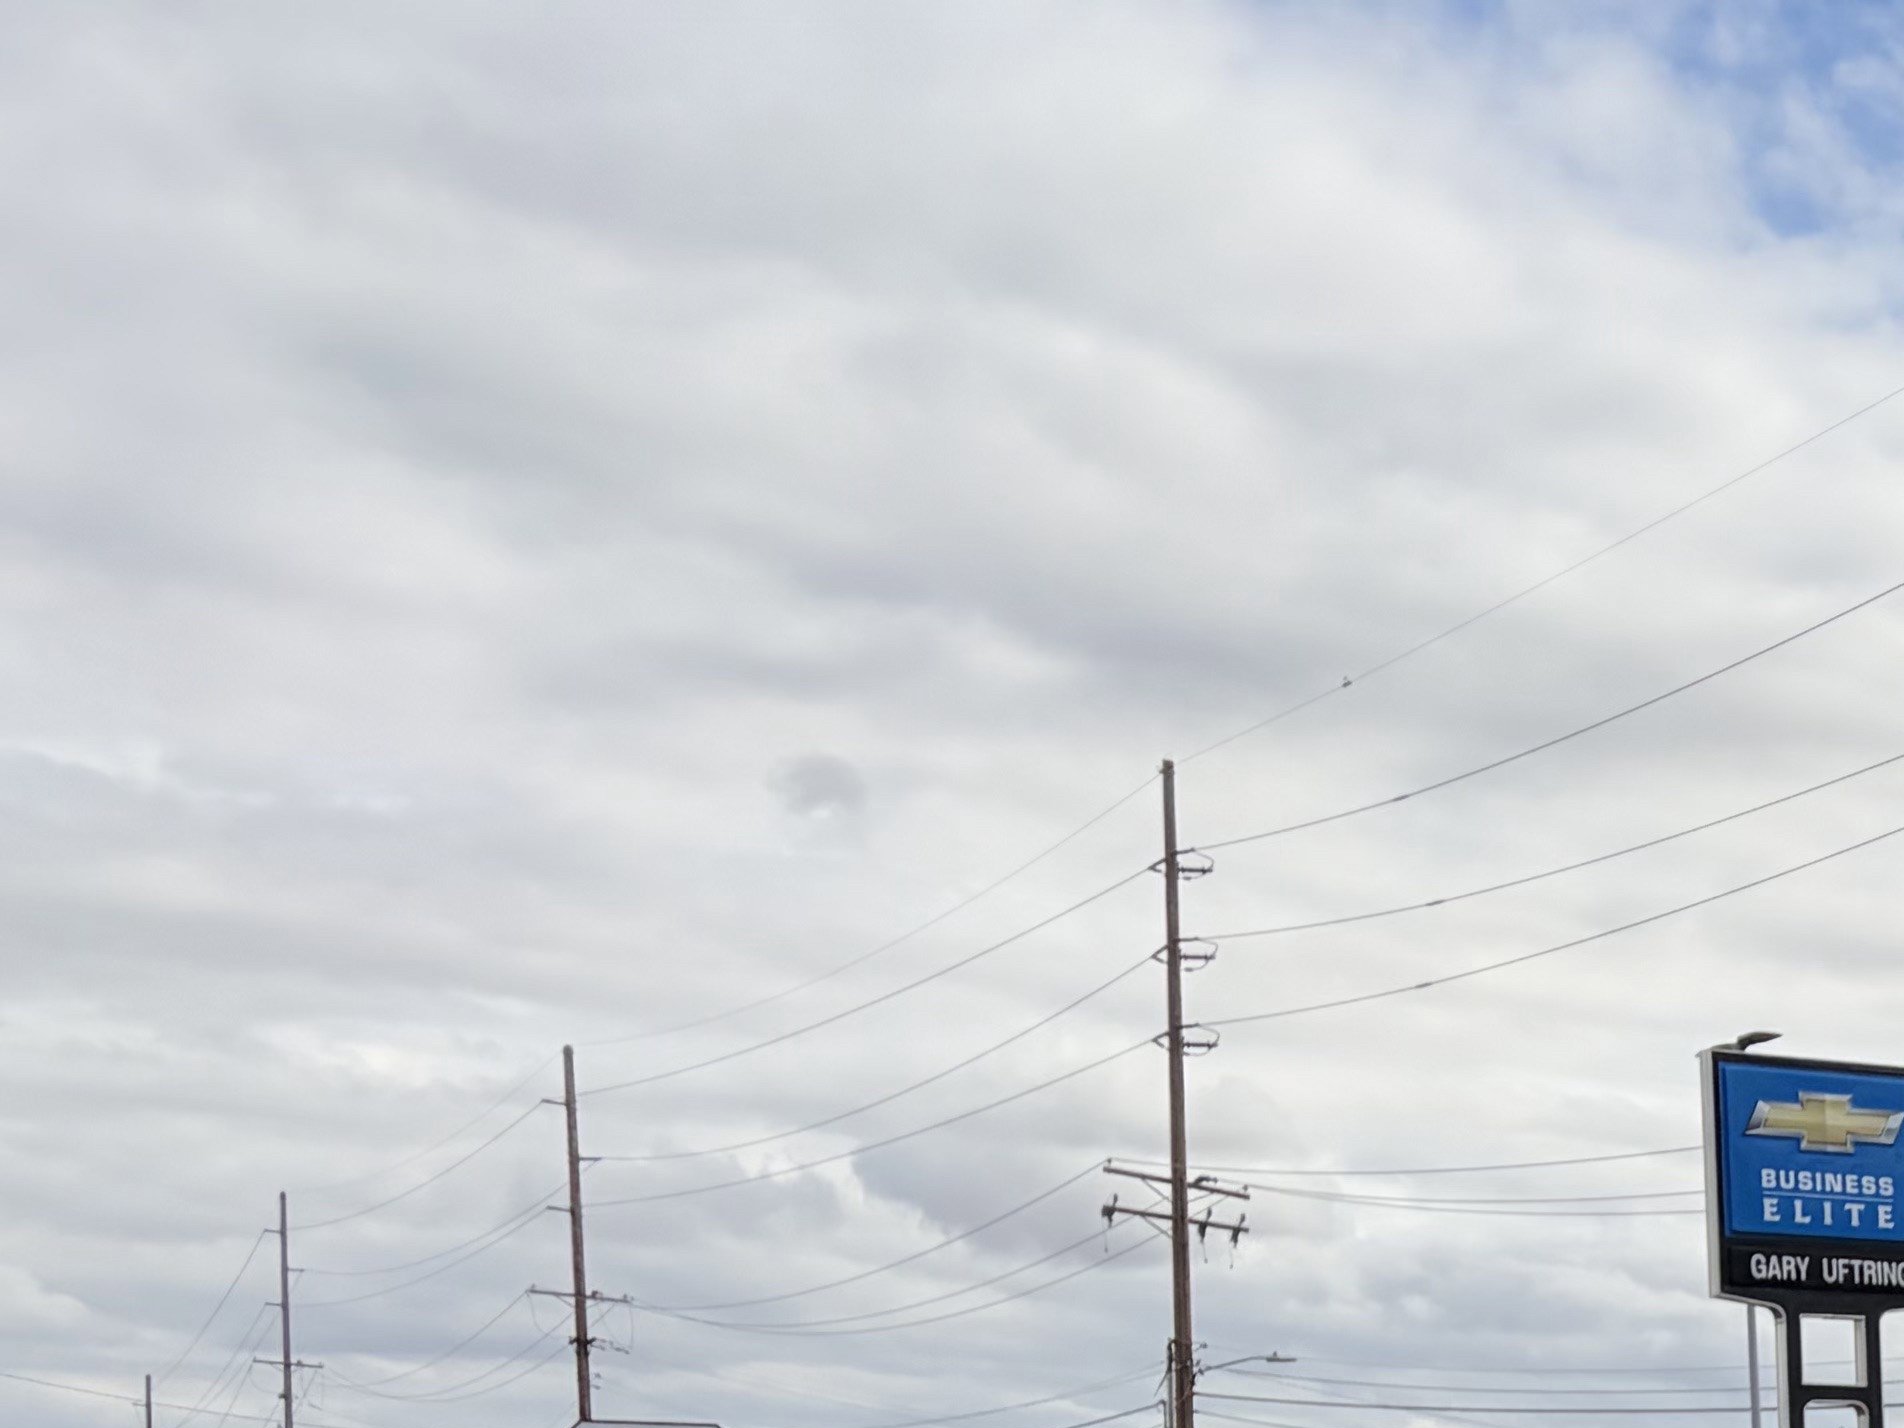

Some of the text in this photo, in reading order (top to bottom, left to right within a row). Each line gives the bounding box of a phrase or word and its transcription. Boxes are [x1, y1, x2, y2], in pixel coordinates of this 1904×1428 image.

[1761, 1168, 1894, 1196] BUSINESS
[1763, 1197, 1895, 1229] ELITE
[1750, 1253, 1810, 1282] GARY
